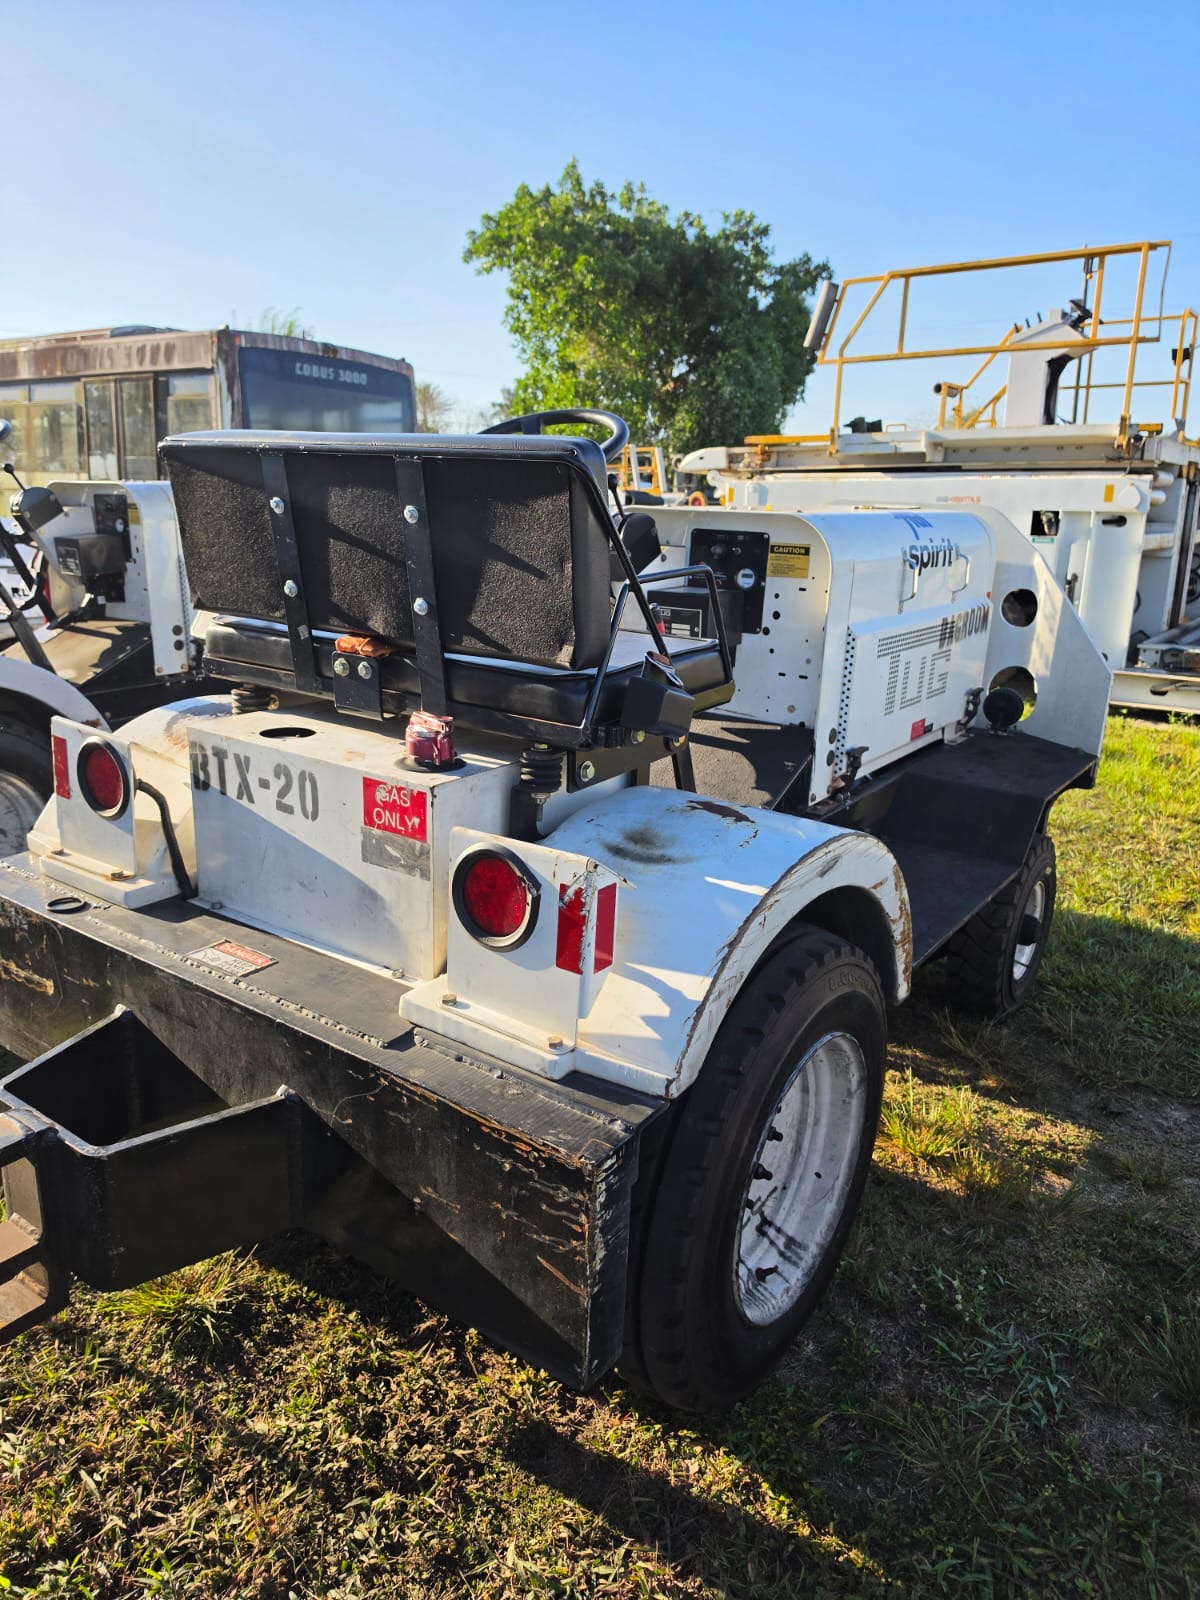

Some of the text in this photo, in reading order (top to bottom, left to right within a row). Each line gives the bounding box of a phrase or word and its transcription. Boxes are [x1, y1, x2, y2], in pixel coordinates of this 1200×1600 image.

[295, 361, 368, 385] COBUS 3000
[773, 546, 806, 555] CAUTION
[908, 537, 954, 577] spirit
[190, 741, 320, 823] BTX-20
[376, 784, 411, 807] GAS
[373, 807, 418, 833] ONLY
